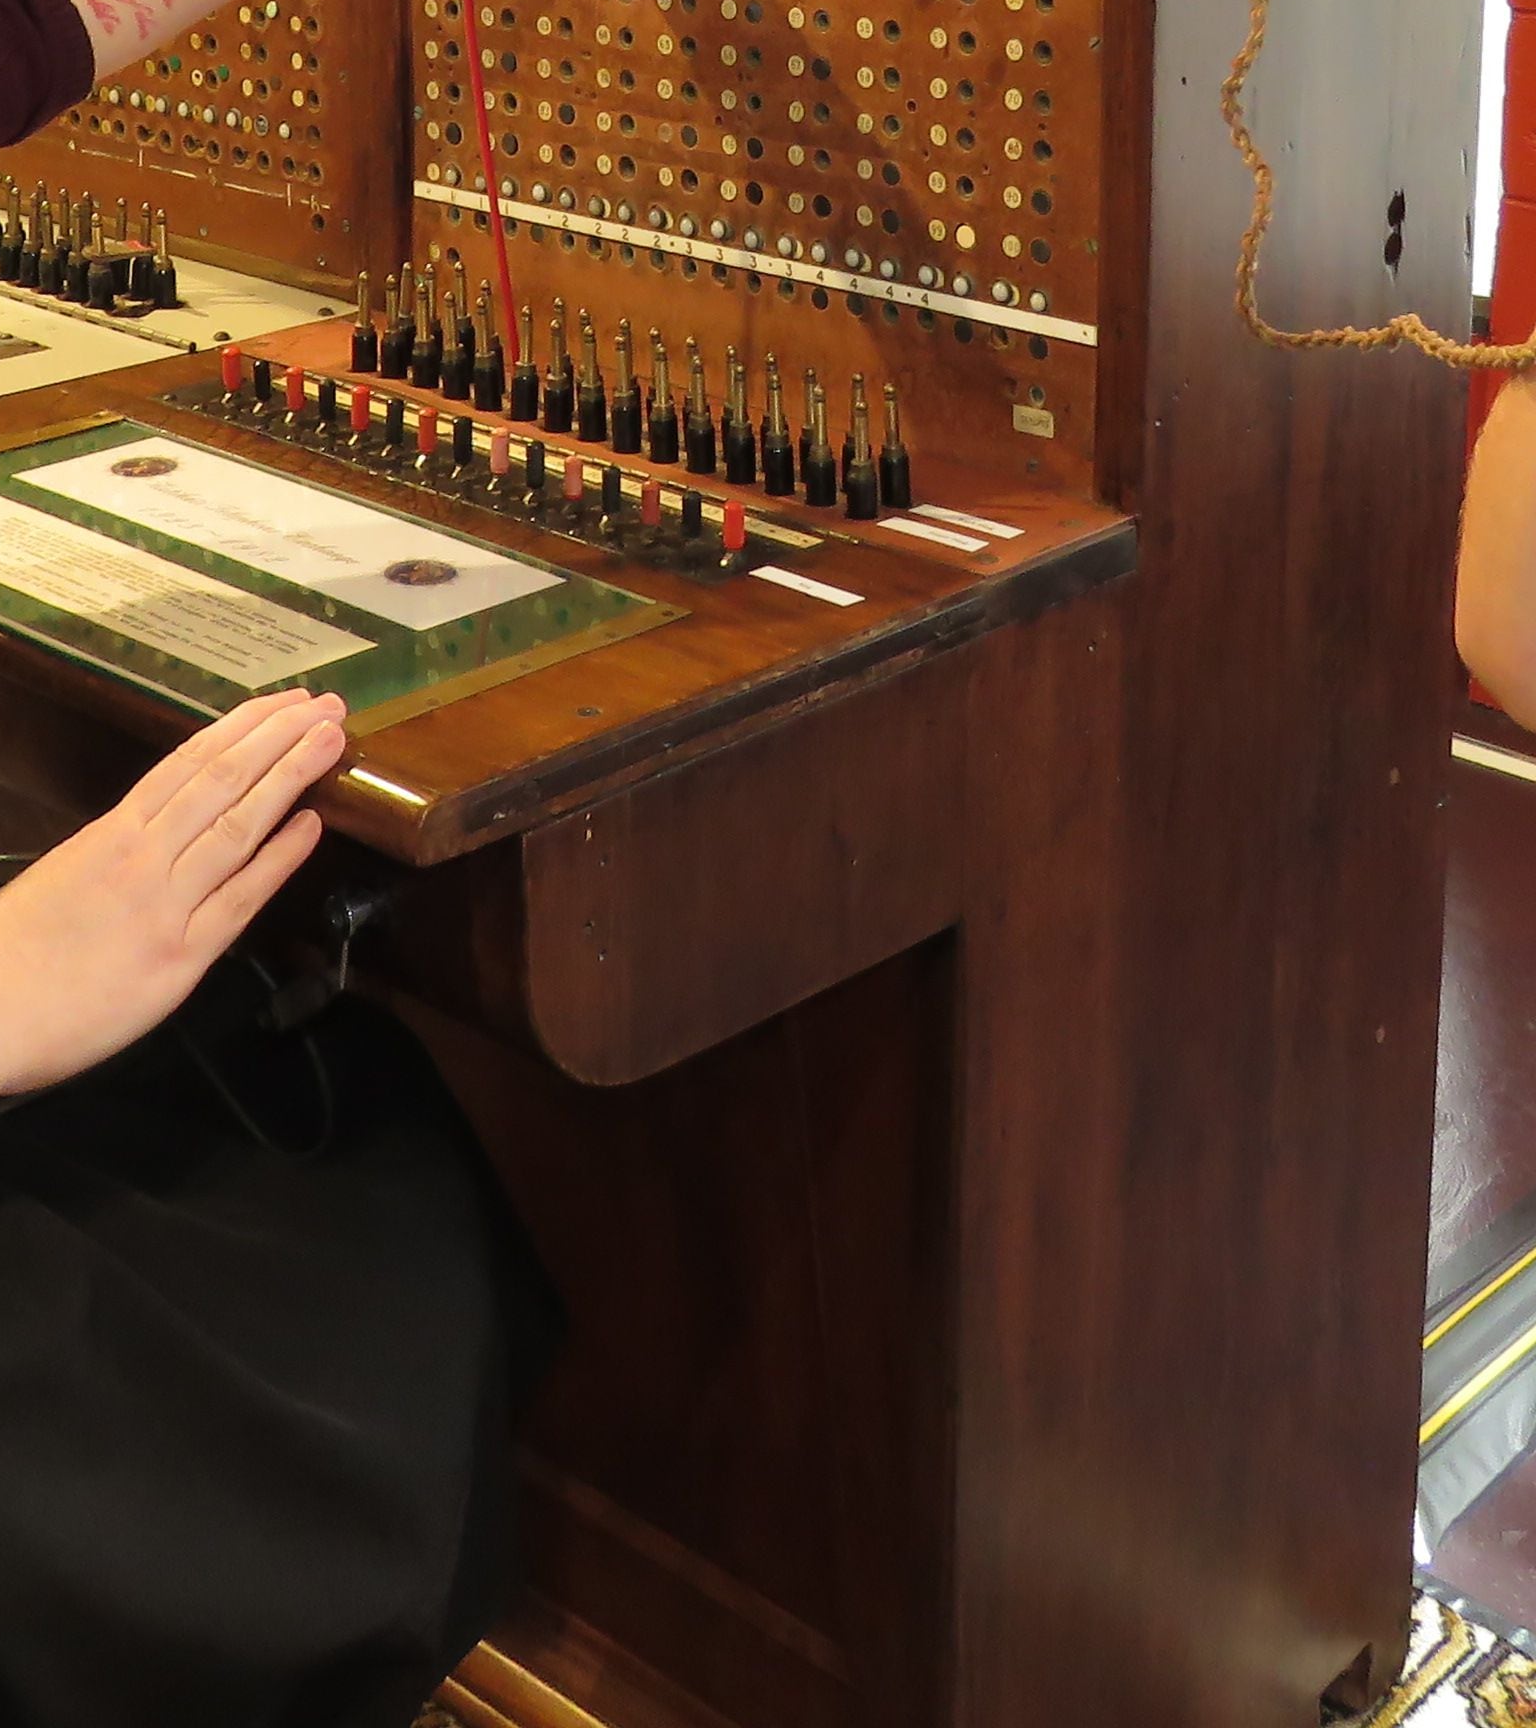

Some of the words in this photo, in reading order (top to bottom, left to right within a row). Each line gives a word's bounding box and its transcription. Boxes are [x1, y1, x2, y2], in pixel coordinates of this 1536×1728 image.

[562, 215, 569, 227] 2
[595, 223, 602, 235] 2
[622, 229, 629, 241] 2
[653, 235, 660, 247] 2
[685, 242, 693, 254] 3
[716, 249, 723, 261] 3
[749, 255, 757, 268] 3
[785, 263, 793, 276] 3
[816, 270, 824, 283] 4
[850, 278, 858, 290] 4
[885, 285, 894, 298] 4
[921, 293, 930, 306] 4
